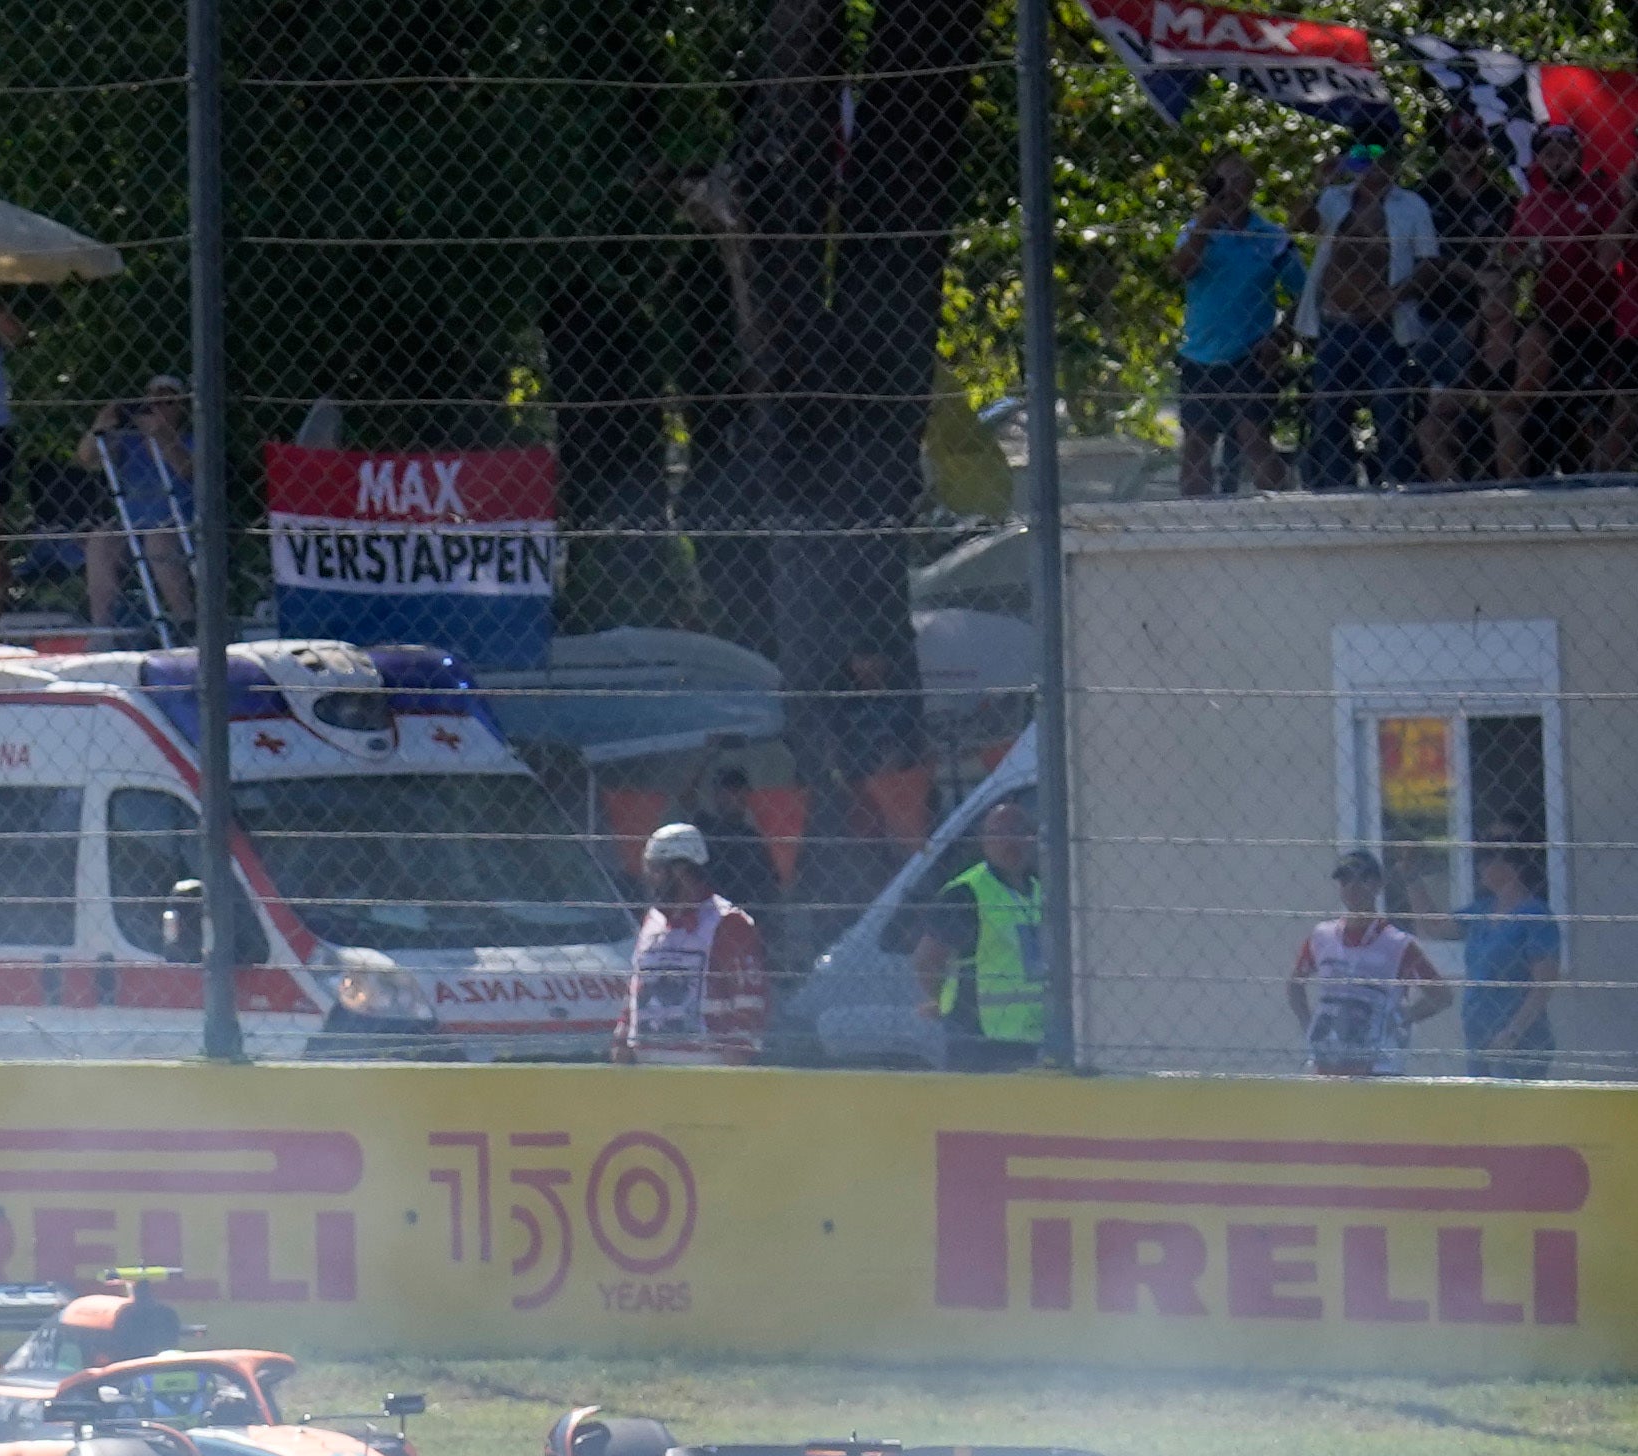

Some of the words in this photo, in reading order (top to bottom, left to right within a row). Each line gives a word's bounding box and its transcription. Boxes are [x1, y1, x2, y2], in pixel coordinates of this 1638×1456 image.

[1150, 2, 1298, 52] MAX
[356, 460, 467, 516] MAX
[287, 528, 551, 585] VERSTAPPEN
[428, 1130, 697, 1310] 150
[935, 1131, 1591, 1326] PIRELLI
[596, 1282, 693, 1313] YEARS
